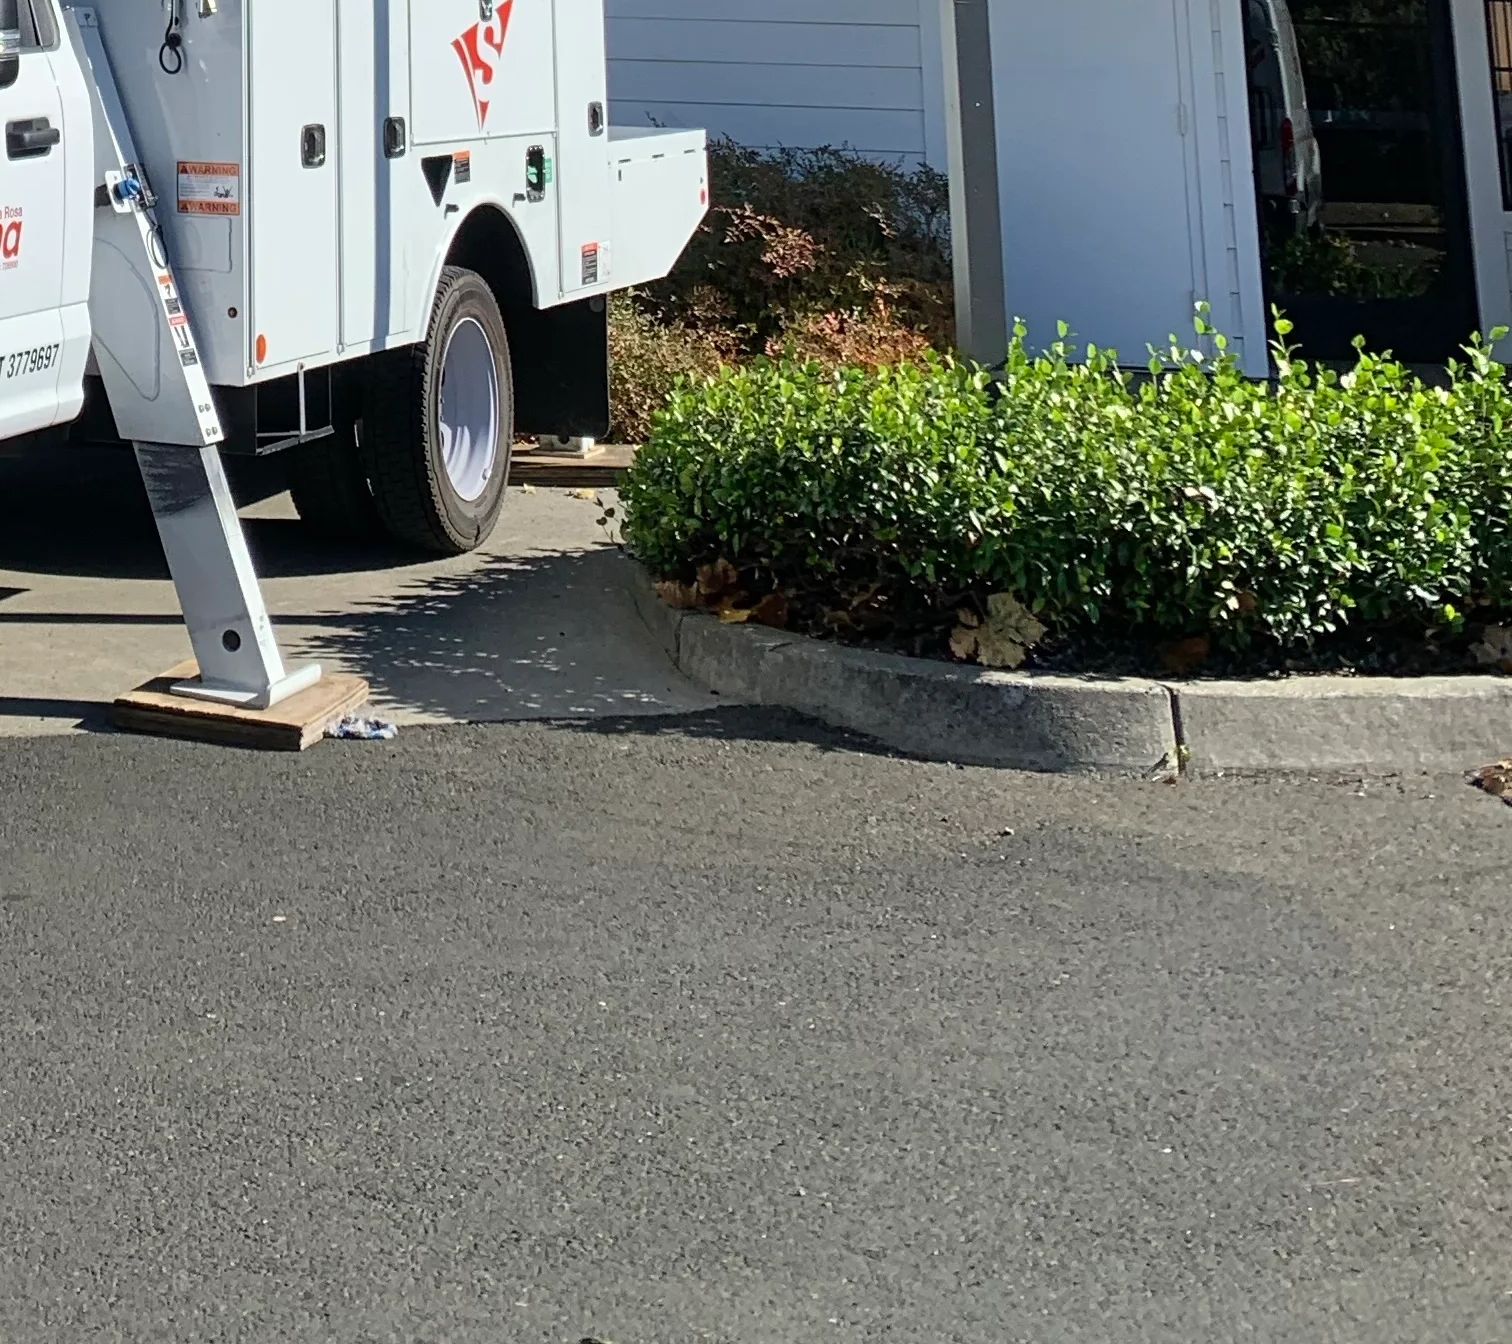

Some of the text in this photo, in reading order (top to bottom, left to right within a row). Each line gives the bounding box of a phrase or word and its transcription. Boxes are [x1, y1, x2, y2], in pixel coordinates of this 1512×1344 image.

[189, 165, 236, 175] WARNING
[4, 205, 23, 219] Rosa
[189, 202, 237, 212] WARNING
[7, 343, 60, 379] 3779697
